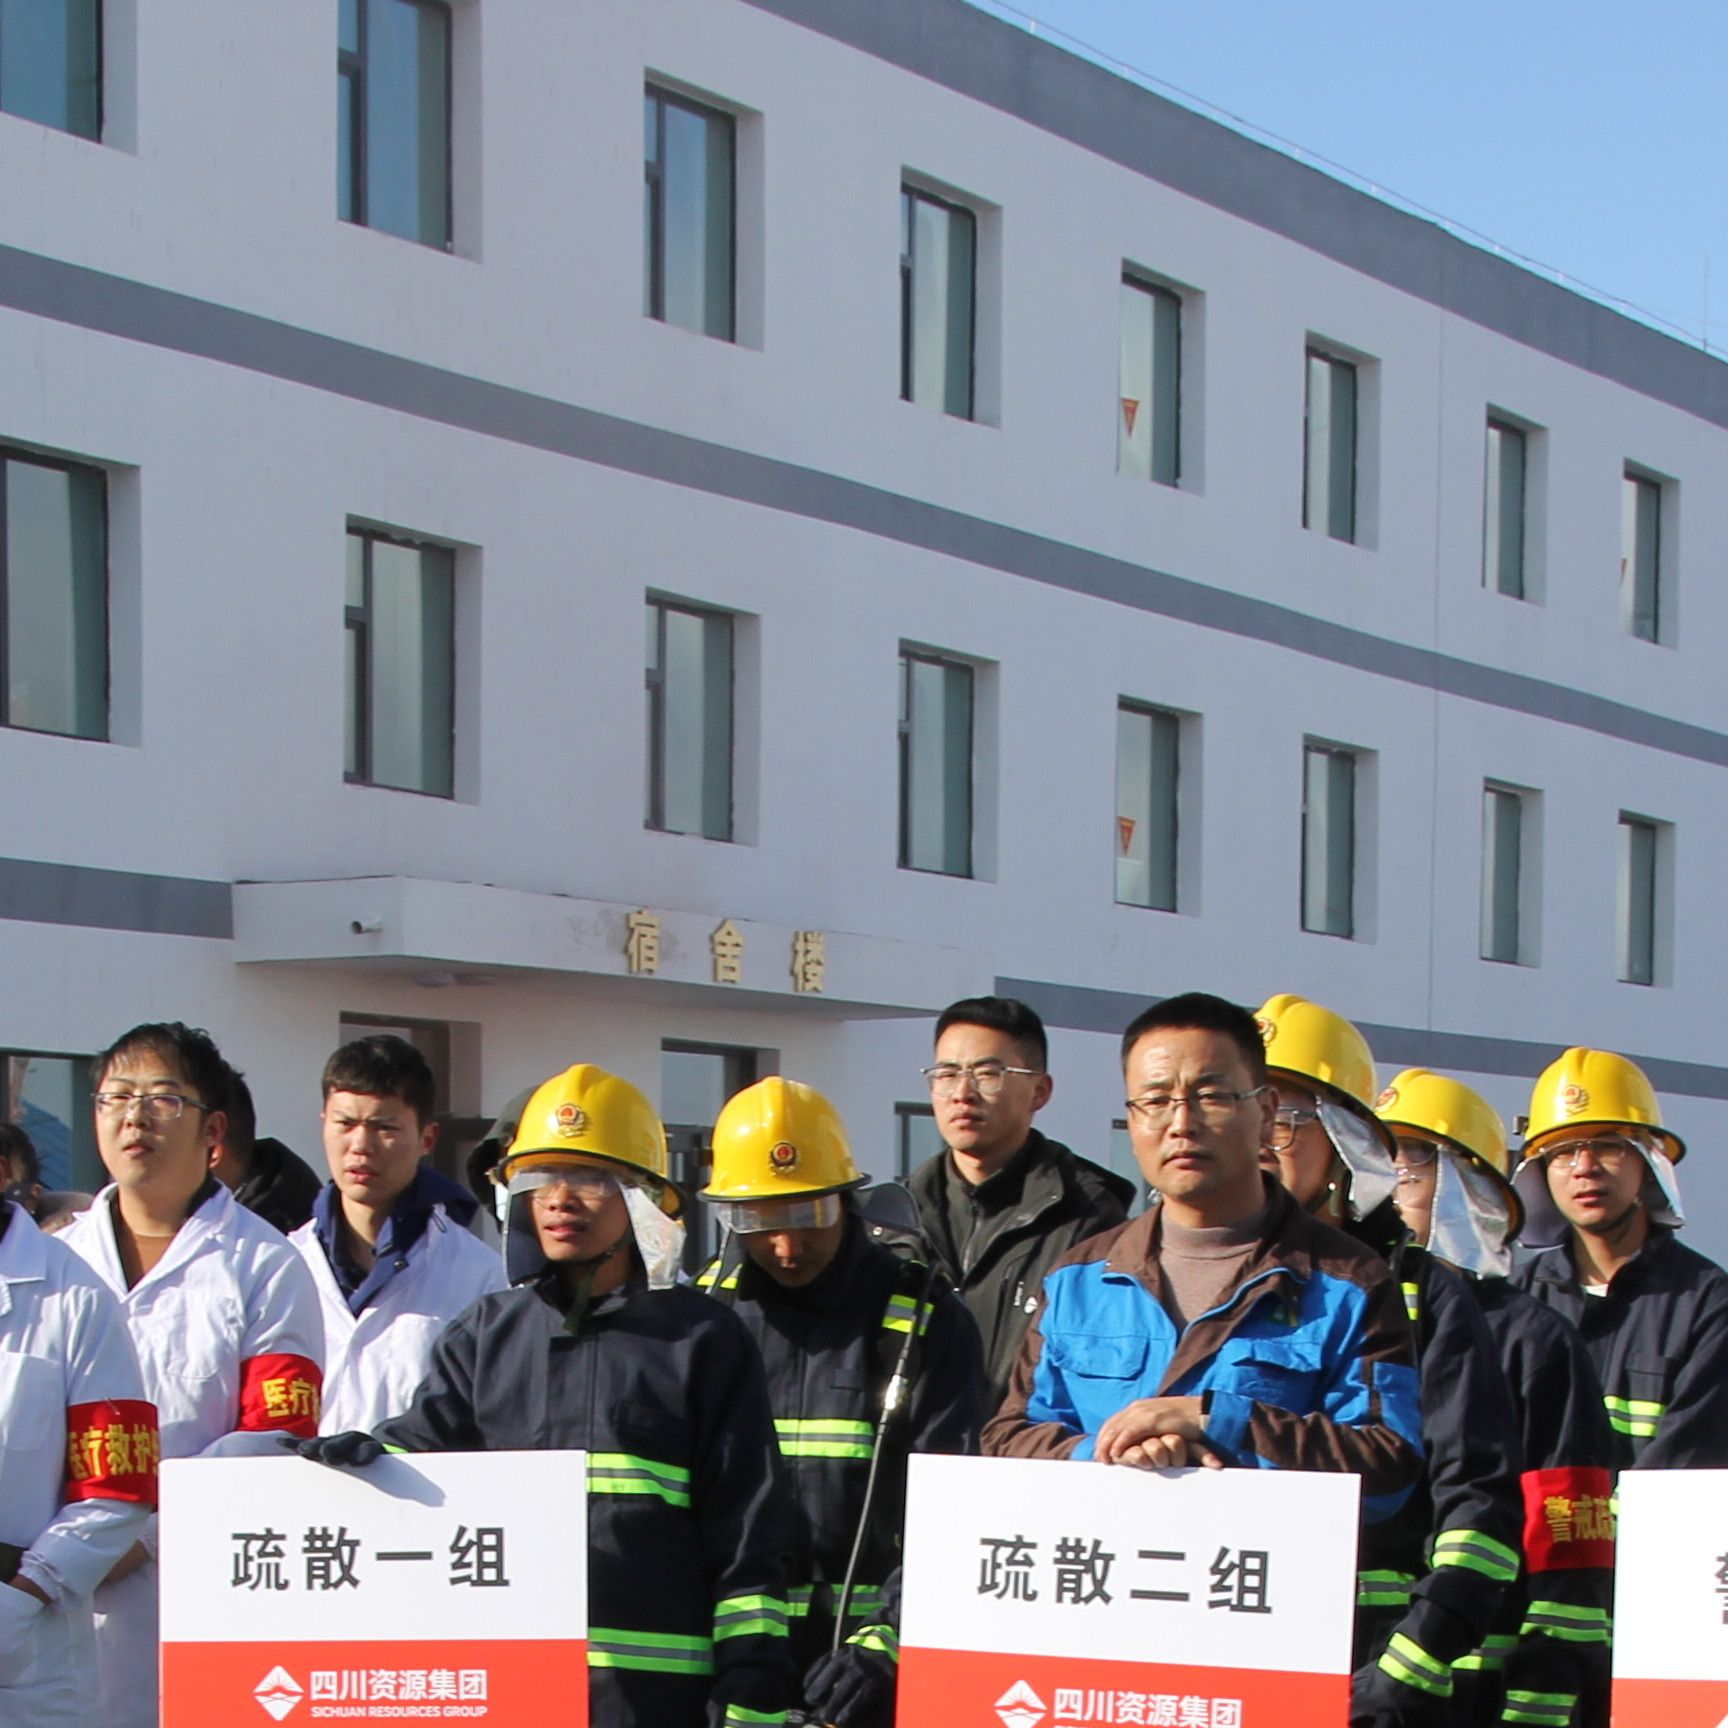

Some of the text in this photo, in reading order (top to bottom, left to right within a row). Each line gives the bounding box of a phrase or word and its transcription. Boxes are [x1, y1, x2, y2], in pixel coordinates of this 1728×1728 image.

[625, 907, 824, 993] 宿舍楼
[261, 1377, 321, 1424] 医疗
[230, 1525, 511, 1591] 疏散一组
[977, 1534, 1273, 1615] 疏散二组
[310, 1669, 488, 1701] 四川资源集团
[311, 1706, 488, 1718] SICHUAN RESOURCES GROUP
